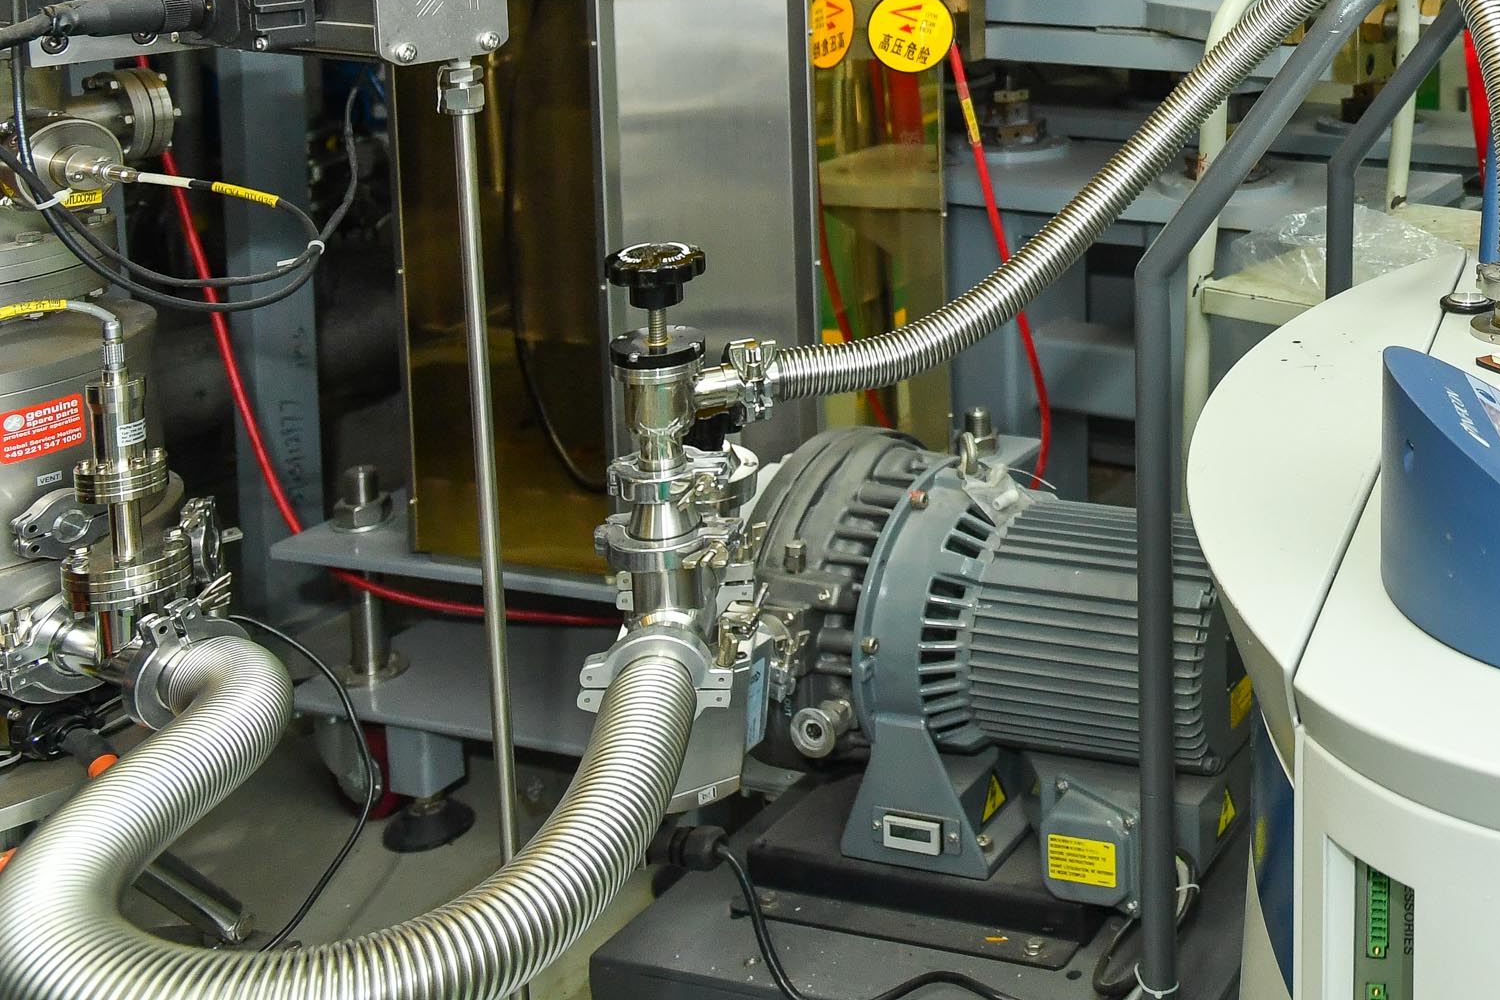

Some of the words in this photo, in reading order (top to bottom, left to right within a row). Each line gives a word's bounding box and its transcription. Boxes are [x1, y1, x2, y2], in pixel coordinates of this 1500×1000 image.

[879, 33, 930, 64] 高压危险
[26, 399, 78, 421] genuine
[27, 415, 53, 428] spare
[56, 407, 79, 421] parts
[3, 431, 31, 442] protect
[32, 426, 50, 436] your
[50, 416, 81, 429] operation
[4, 441, 28, 452] Global
[30, 434, 55, 445] Service
[57, 427, 82, 439] Hotline:
[4, 449, 24, 459] +49
[25, 445, 42, 455] 221
[44, 440, 60, 450] 347
[63, 432, 82, 443] 1000
[40, 473, 61, 484] VENT
